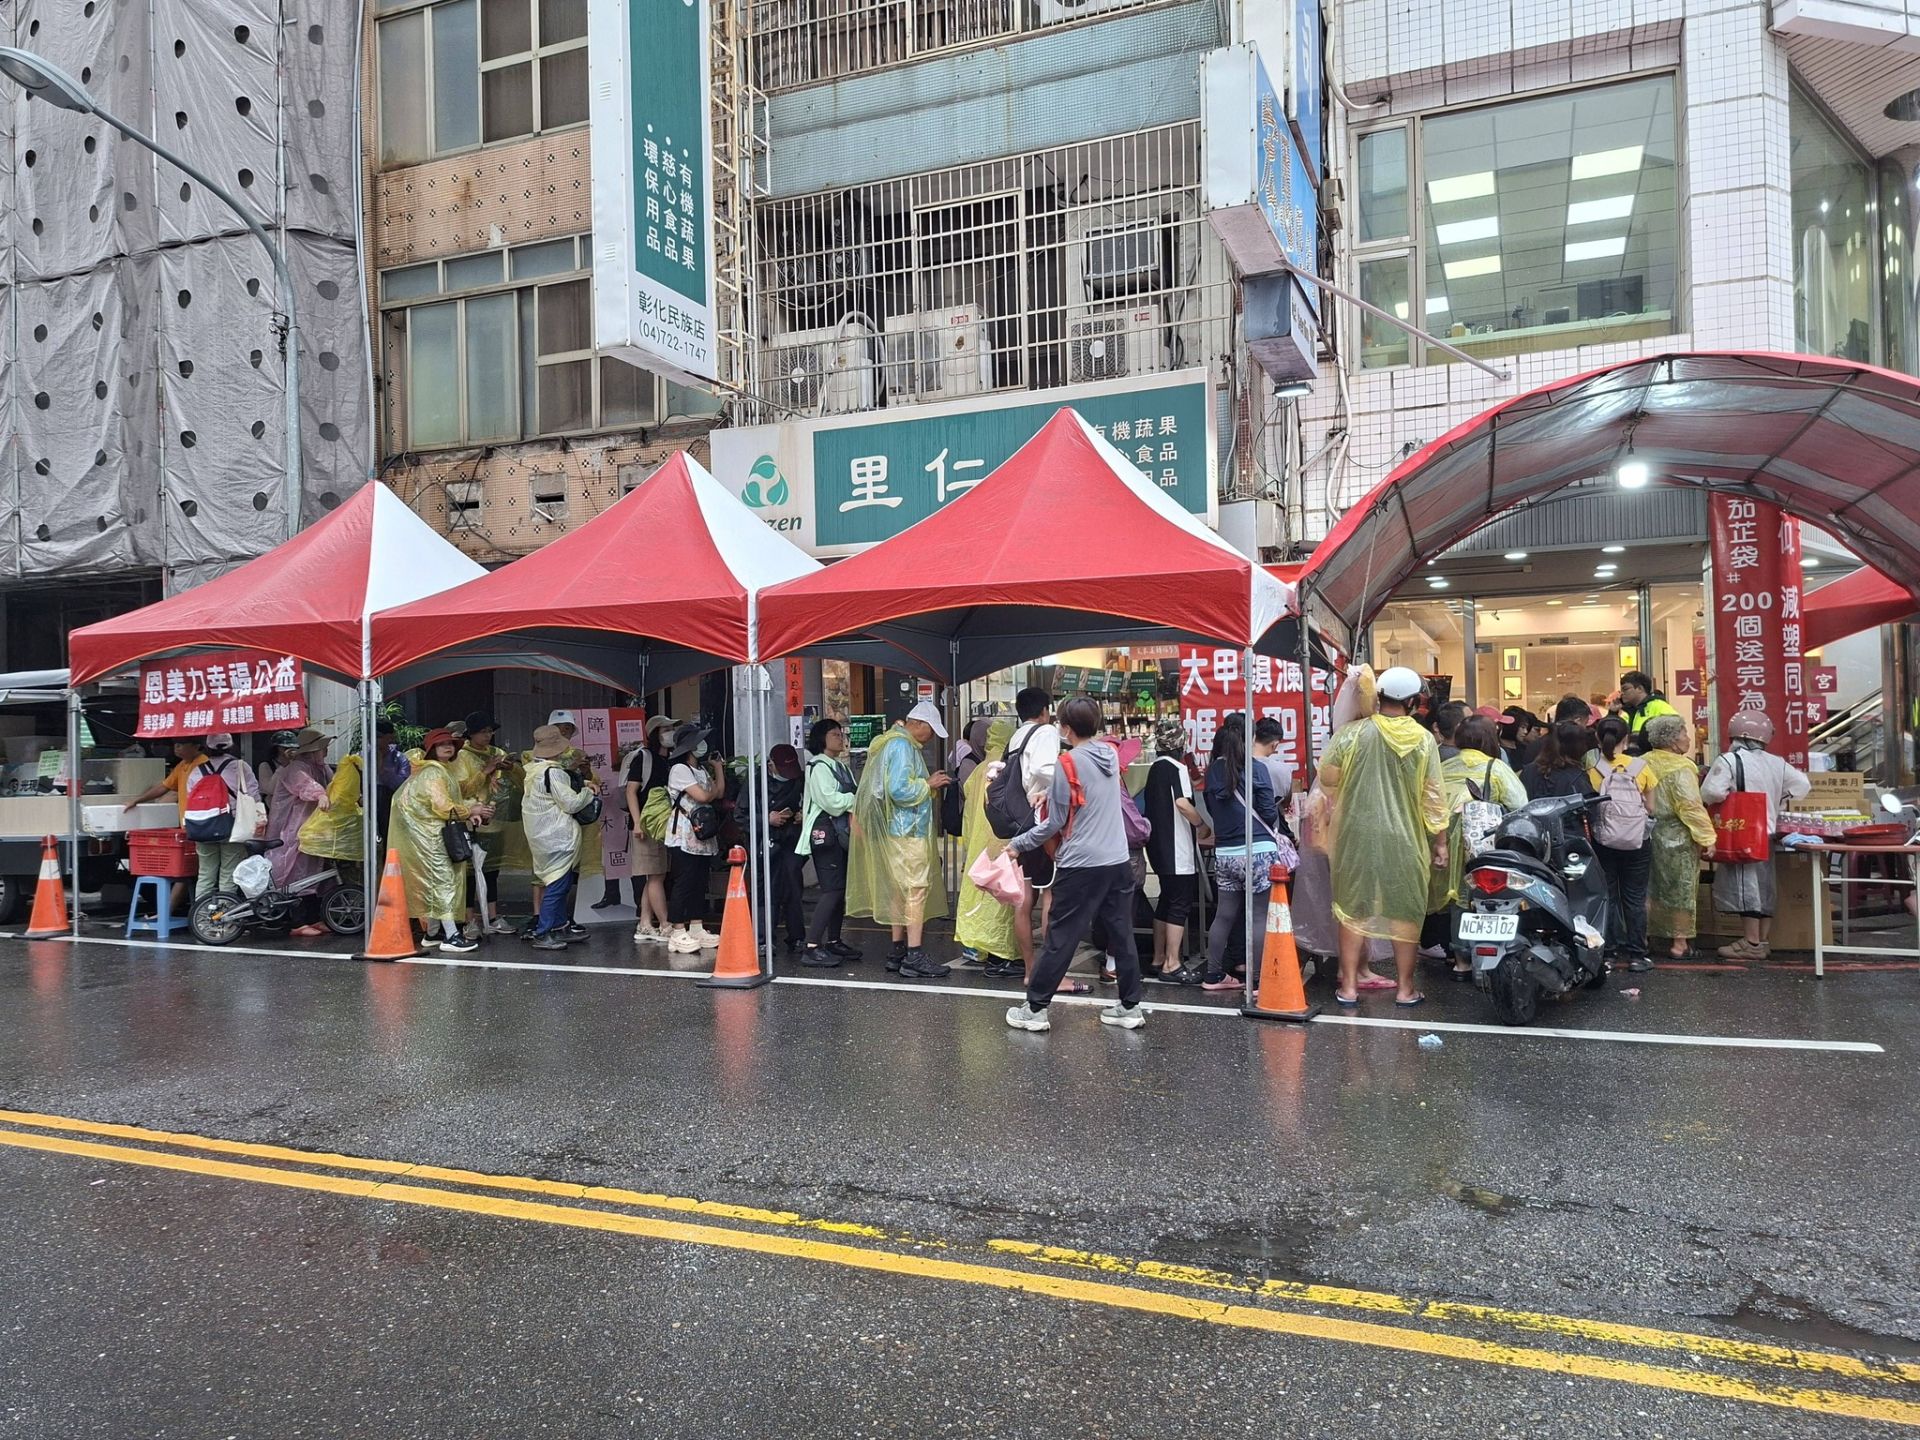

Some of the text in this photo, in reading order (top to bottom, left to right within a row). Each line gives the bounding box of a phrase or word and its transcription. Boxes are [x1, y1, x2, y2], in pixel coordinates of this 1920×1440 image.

[643, 138, 661, 253] 環保用品
[661, 150, 679, 263] 慈心食品
[679, 163, 696, 272] 有機蔬果
[638, 290, 706, 341] 彰化民族店
[639, 320, 707, 363] (04)722-1747
[838, 447, 985, 513] 里仁
[144, 655, 296, 704] 恩美力幸福公益
[1815, 673, 1833, 689] 宮
